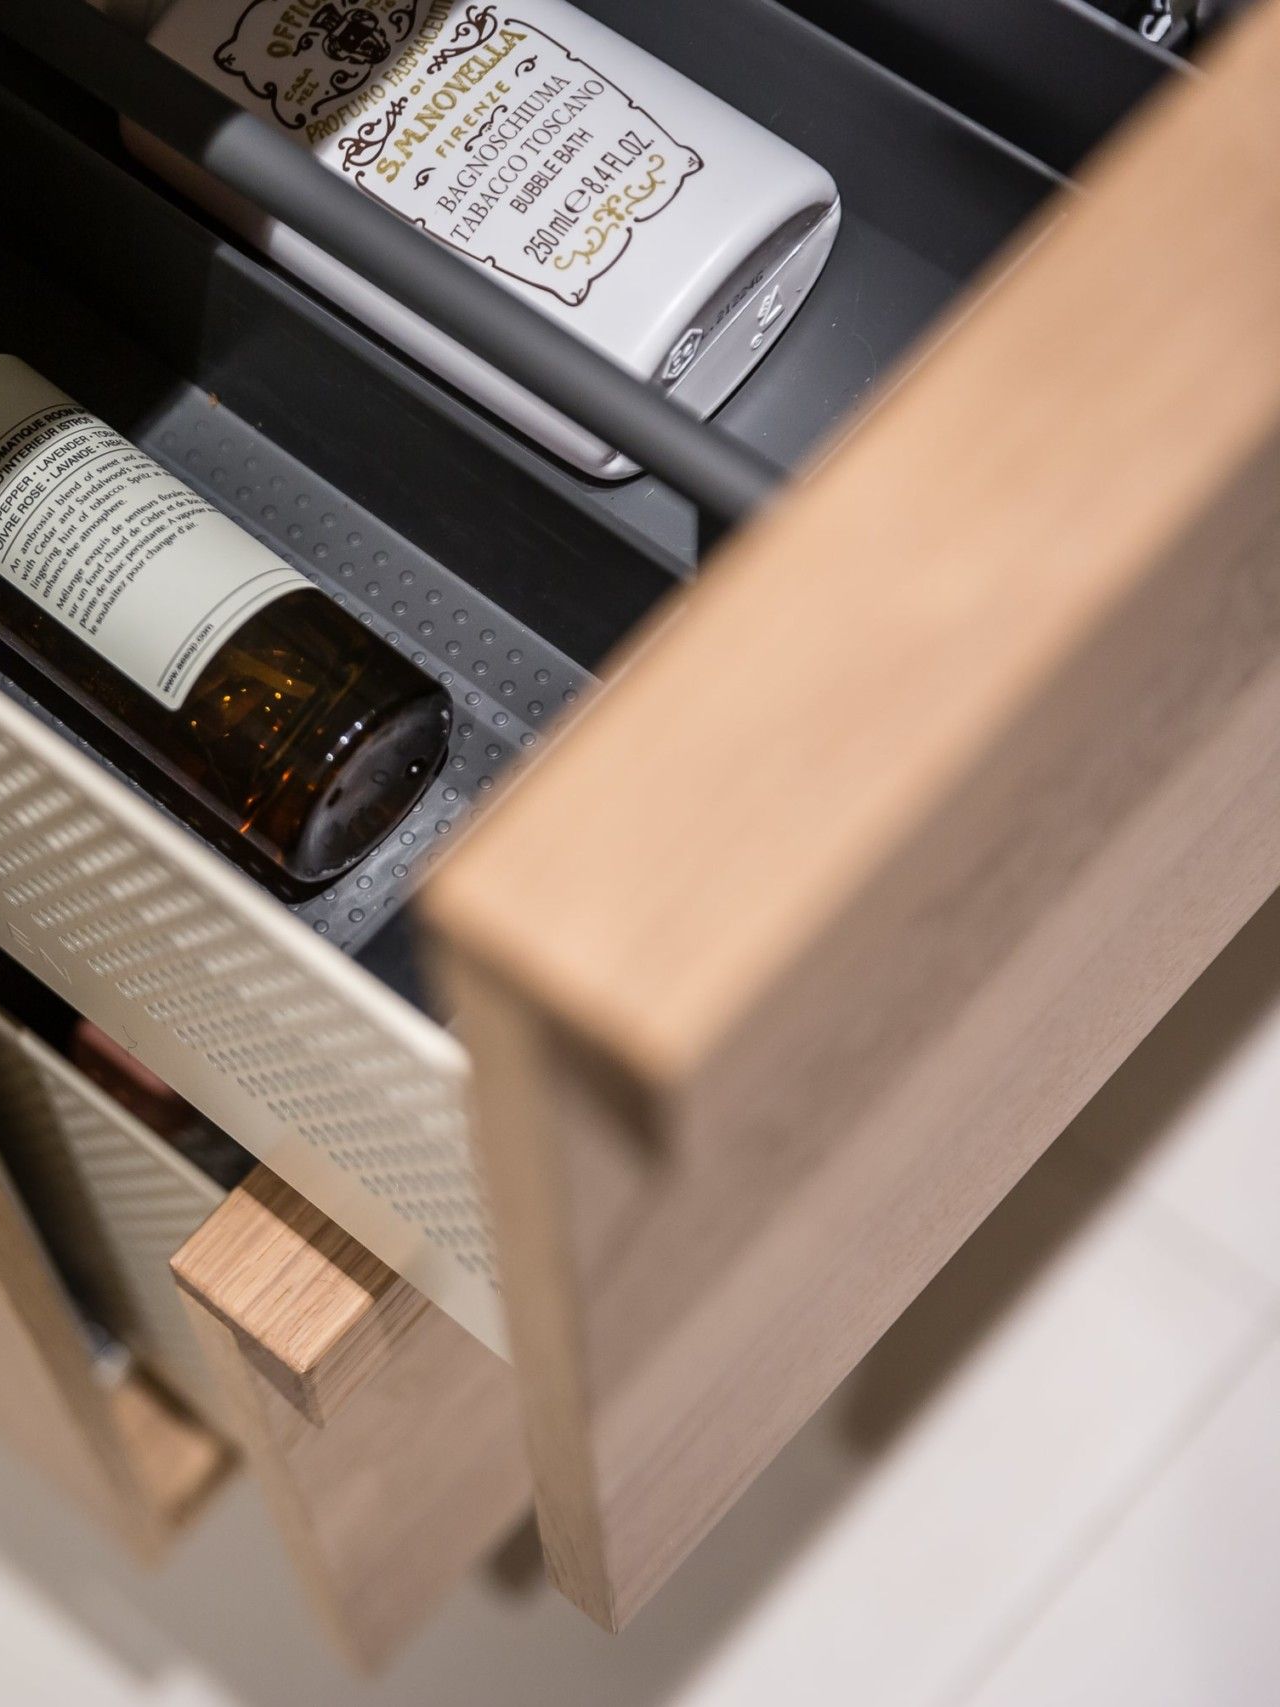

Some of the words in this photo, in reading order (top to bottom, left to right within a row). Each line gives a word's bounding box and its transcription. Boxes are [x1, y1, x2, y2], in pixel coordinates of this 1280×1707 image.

[284, 68, 313, 102] CASA
[305, 84, 386, 145] PROFUMO
[435, 80, 511, 158] FIRENZE
[436, 74, 571, 215] BAGNOSCHIUMA
[450, 154, 528, 243] TABACCO
[520, 79, 605, 156] TOSCANO
[510, 159, 562, 214] BUBBLE
[552, 127, 594, 165] BATH
[581, 165, 615, 195] 8.4
[20, 482, 47, 515] ROSE
[49, 447, 96, 479] LAVANDE
[36, 435, 90, 472] LAVENDER
[9, 557, 21, 573] An
[21, 507, 56, 555] ambrosial
[54, 481, 82, 506] blend
[84, 471, 94, 482] of
[96, 459, 120, 474] sweet
[21, 558, 36, 581] with
[34, 526, 58, 556] Cedar
[58, 505, 76, 525] and
[75, 466, 132, 505] Sandalwood's
[29, 546, 63, 590] lingering
[58, 524, 77, 544] hint
[78, 510, 89, 523] of
[89, 484, 127, 512] tobacco.
[42, 557, 69, 599] enhance
[65, 541, 81, 558] the
[79, 499, 127, 543] atmosphere.
[56, 567, 85, 610] Mélange
[84, 537, 111, 567] exquis
[111, 523, 123, 536] de
[124, 500, 159, 524] senteurs
[68, 602, 79, 619] sur
[77, 587, 89, 602] un
[85, 562, 105, 587] fond
[104, 535, 130, 564] chaud
[129, 526, 141, 538] de
[140, 508, 166, 527] Cèdre
[78, 596, 97, 629] pointe
[96, 582, 107, 597] de
[104, 560, 126, 584] tabac
[88, 624, 98, 636] le
[95, 579, 127, 625] souhaitez
[126, 560, 146, 582] pour
[145, 532, 177, 560] changer
